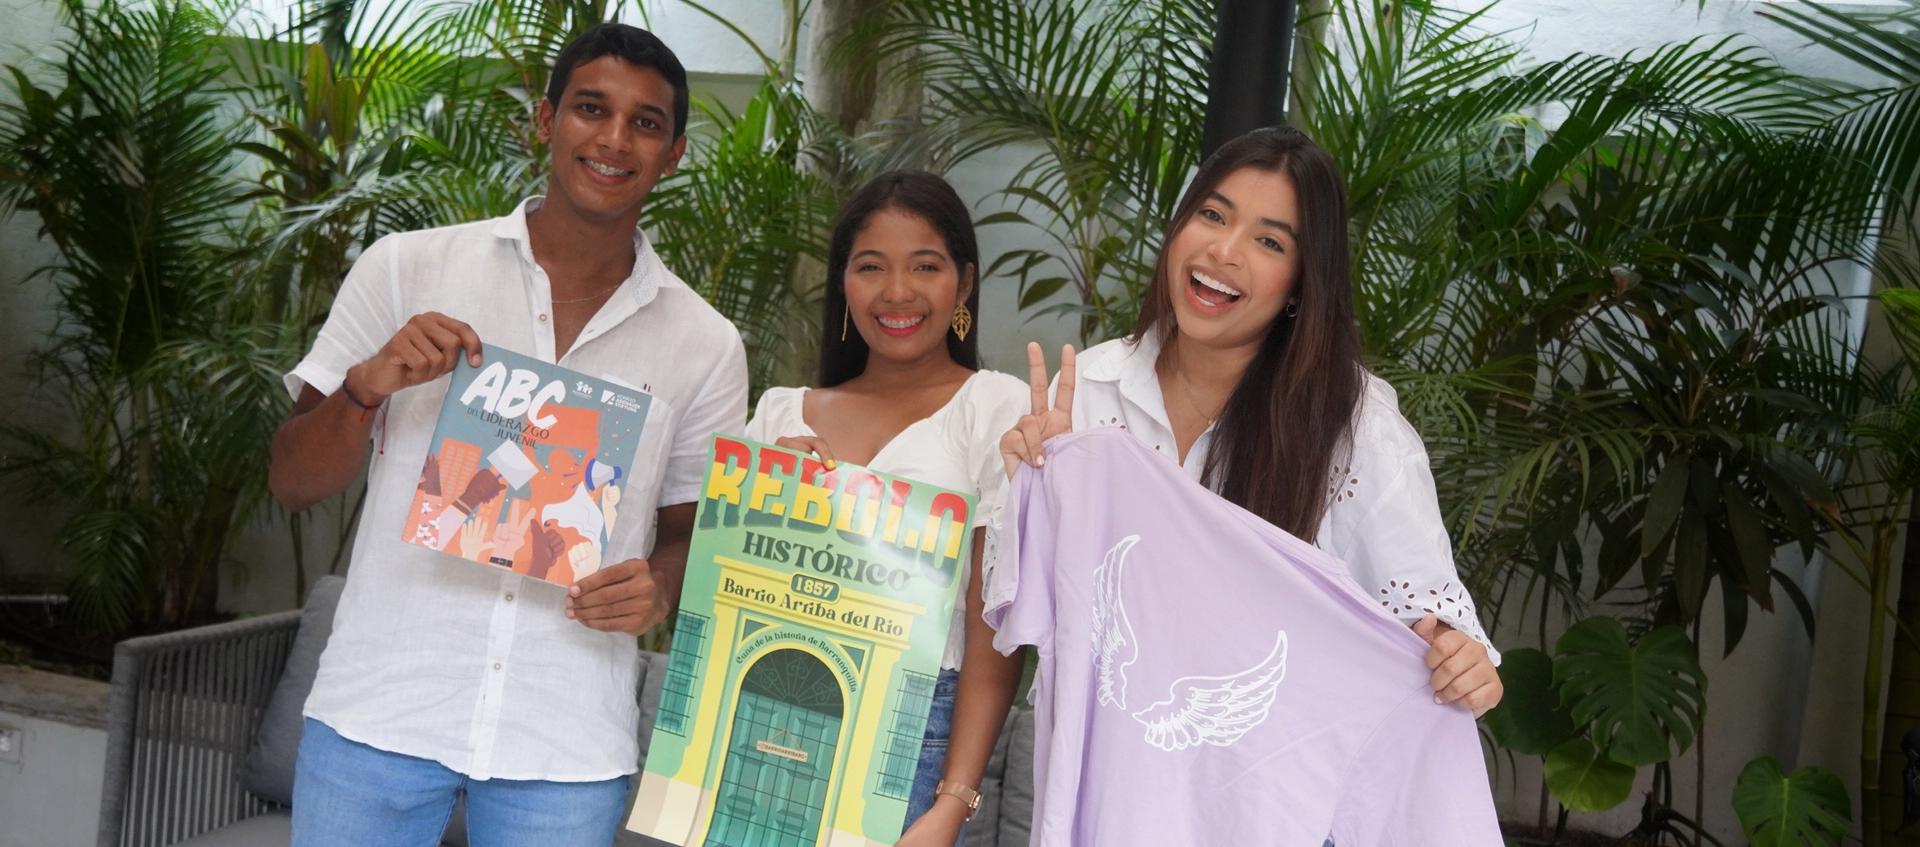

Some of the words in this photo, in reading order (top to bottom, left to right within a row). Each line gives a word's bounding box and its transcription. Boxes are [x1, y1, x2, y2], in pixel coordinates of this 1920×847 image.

[460, 361, 566, 429] ABC
[480, 411, 550, 440] LIDERAZGO
[496, 429, 537, 448] JUVENIL
[699, 436, 969, 589] REBOLO
[742, 531, 911, 591] HISTÓRICO
[796, 576, 834, 598] 1857
[723, 577, 776, 604] Barrio
[780, 593, 836, 621] Arriba
[841, 611, 870, 629] del
[736, 646, 754, 664] Cuna
[754, 639, 764, 648] de
[774, 631, 806, 641] historia
[807, 635, 818, 645] de
[818, 640, 857, 693] Barranquilla
